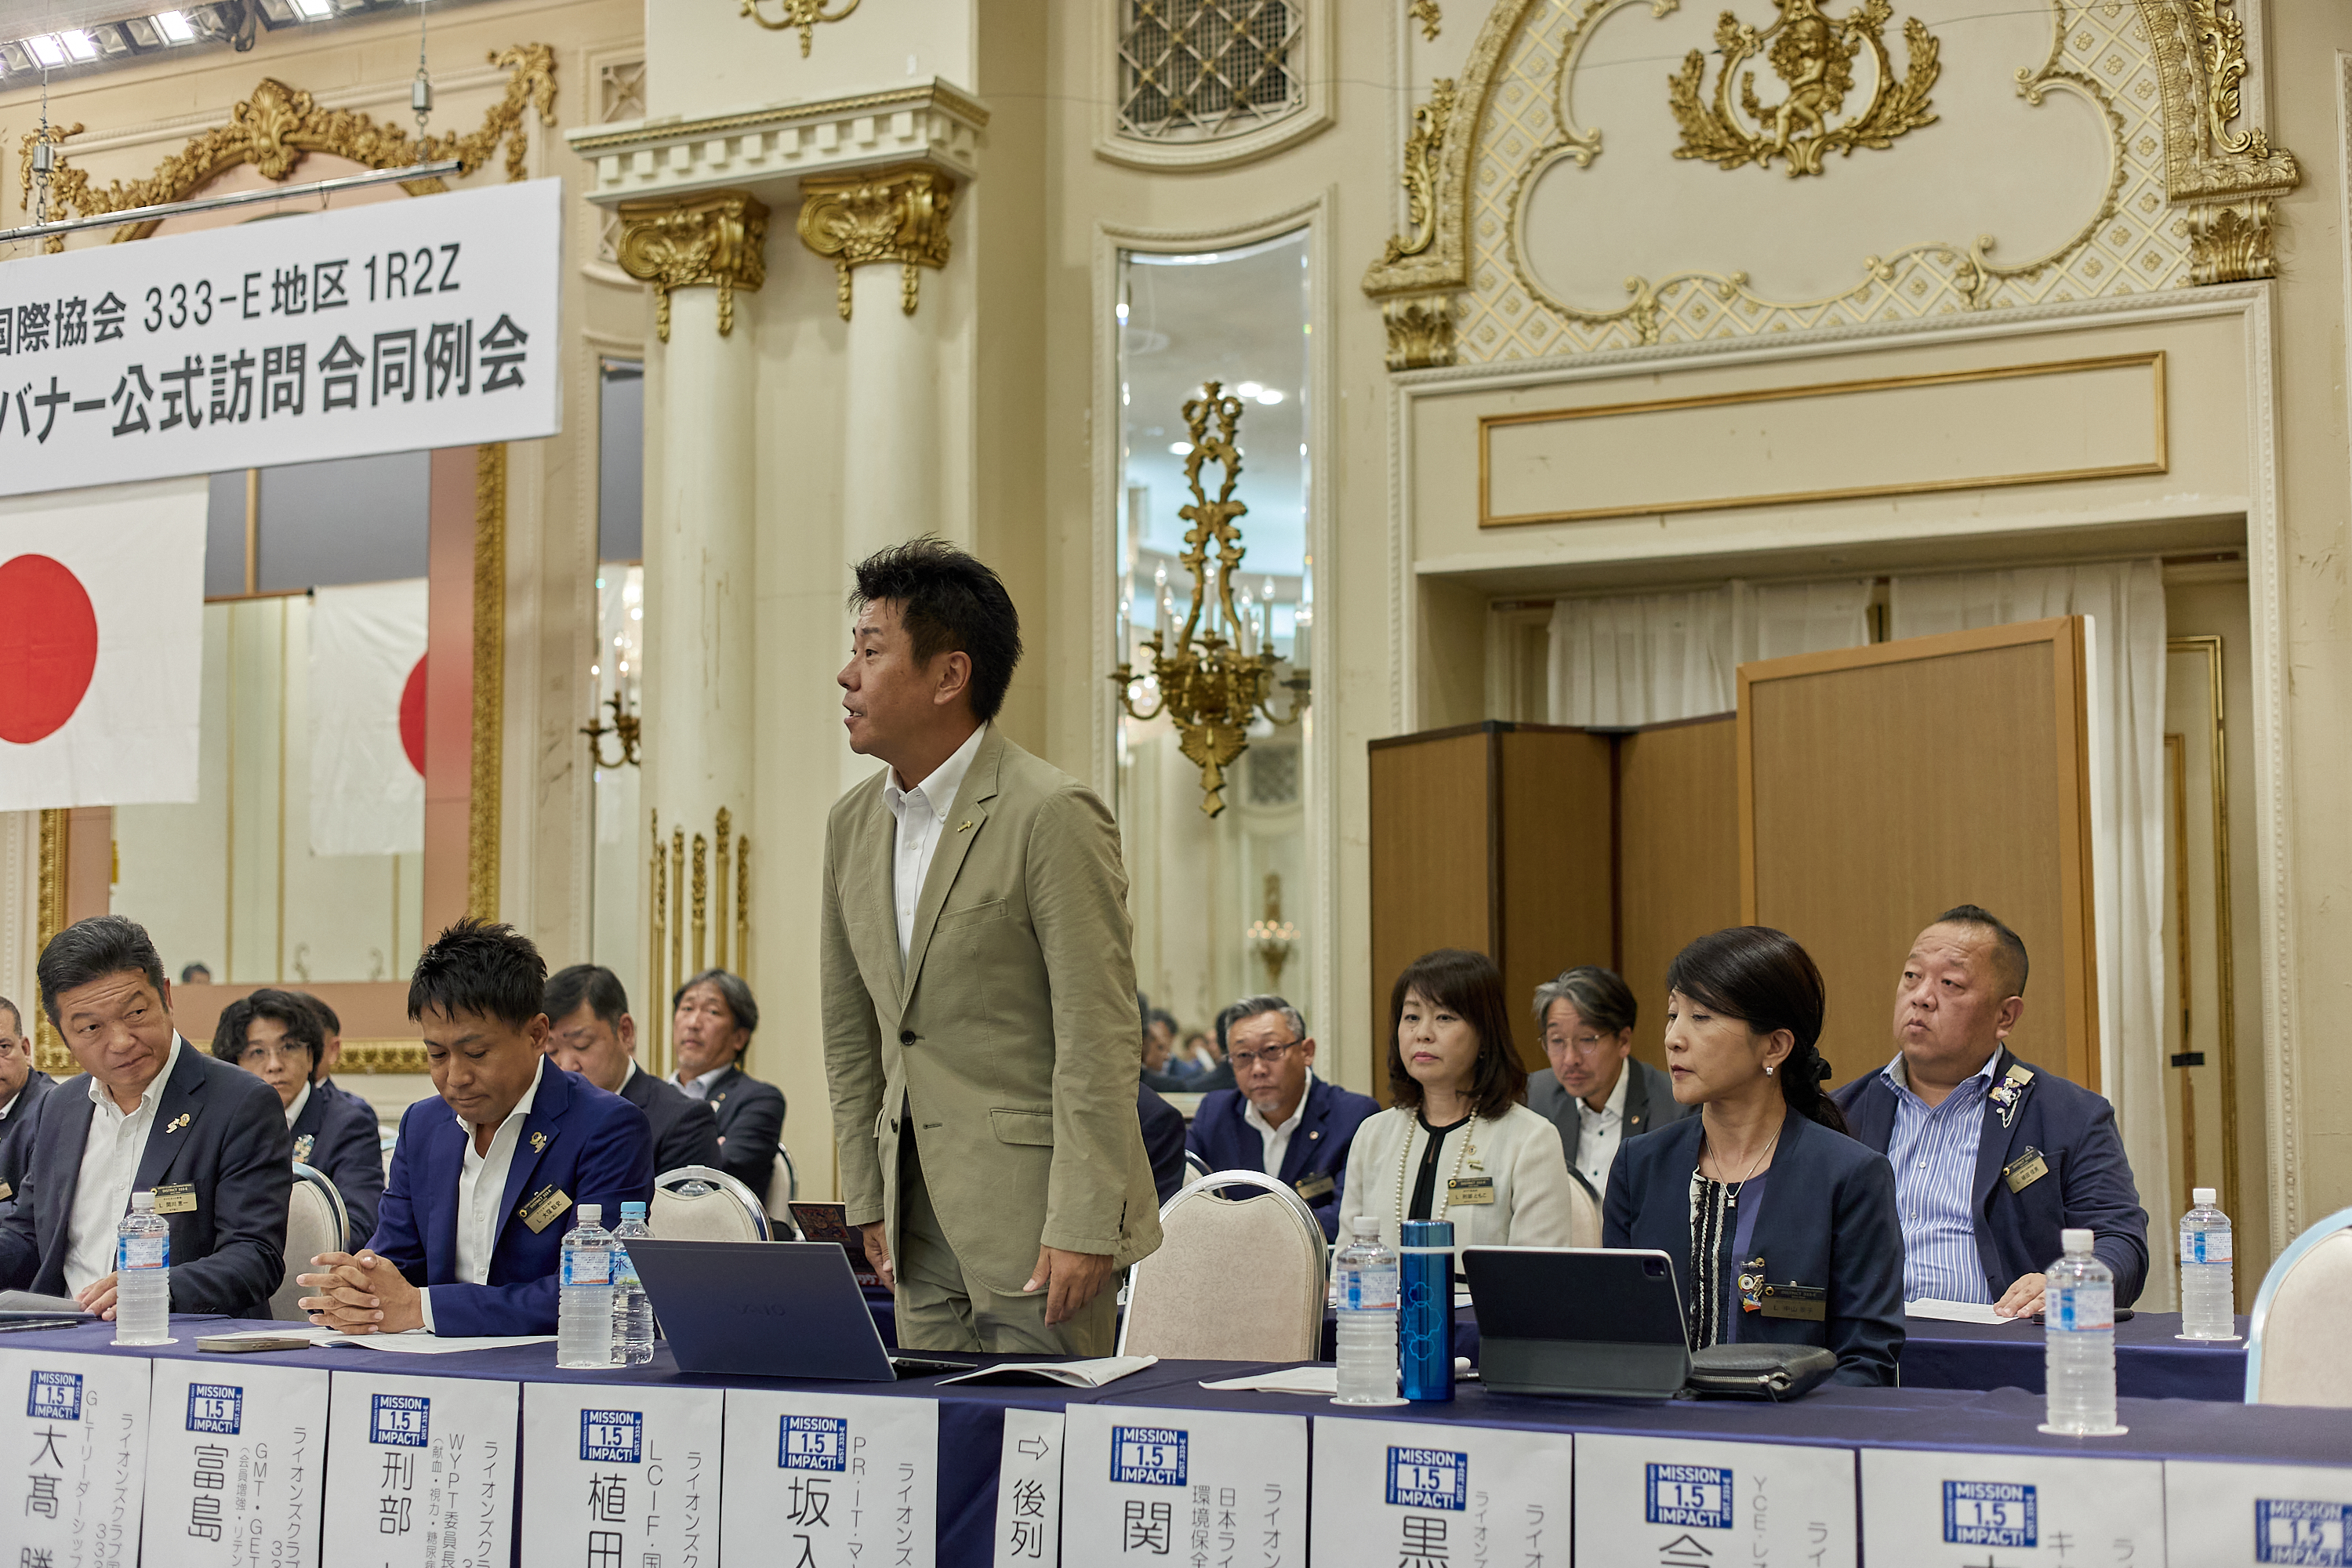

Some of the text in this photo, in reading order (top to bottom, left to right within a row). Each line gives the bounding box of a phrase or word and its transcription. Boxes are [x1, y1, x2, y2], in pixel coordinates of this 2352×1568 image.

[365, 243, 461, 302] 1R2Z
[0, 314, 528, 445] バナー公式訪問合同例会
[615, 1258, 629, 1271] 水
[38, 1372, 75, 1385] MISSION
[47, 1386, 64, 1404] 1.5
[196, 1385, 235, 1399] MISSION
[380, 1396, 422, 1410] MISSION
[34, 1405, 73, 1419] IMPACT!
[205, 1399, 223, 1418] 1.5
[590, 1411, 634, 1425] MISSION
[194, 1419, 233, 1433] IMPACT!
[390, 1411, 410, 1430] 1.5
[789, 1417, 837, 1432] MISSION
[378, 1431, 420, 1446] IMPACT!
[601, 1426, 622, 1446] 1.5
[801, 1433, 825, 1454] 1.5
[1123, 1428, 1178, 1444] MISSION
[589, 1446, 633, 1461] IMPACT!
[788, 1454, 837, 1470] IMPACT!
[1137, 1445, 1163, 1466] 1.5
[1399, 1448, 1456, 1467] MISSION
[1121, 1467, 1177, 1484] IMPACT!
[1413, 1466, 1440, 1490] 1.5
[1658, 1465, 1720, 1484] MISSION
[188, 1443, 229, 1542] 富島
[379, 1451, 414, 1537] 刑部
[847, 1436, 866, 1568] PR・IT・マ
[1397, 1490, 1454, 1509] IMPACT!
[1675, 1484, 1704, 1508] 1.5
[1956, 1483, 2024, 1501] MISSION
[588, 1472, 627, 1568] 植田
[683, 1452, 702, 1568] ライオンズク
[895, 1463, 914, 1566] ライオンズ
[1011, 1479, 1046, 1559] 後列
[1658, 1508, 1720, 1527] IMPACT!
[1974, 1502, 2006, 1526] 1.5
[787, 1475, 832, 1568] 坂入
[1123, 1500, 1171, 1555] 関
[1190, 1485, 1210, 1568] 環境保全
[1218, 1487, 1236, 1568] 日本ライ
[1263, 1483, 1282, 1568] ライオン
[1752, 1475, 1769, 1568] YCE・レ
[1399, 1515, 1450, 1568] 黒
[1525, 1504, 1544, 1568] ライオ
[1807, 1522, 1828, 1567] ライ
[2290, 1520, 2324, 1550] 1.5
[2047, 1530, 2074, 1568] キ
[2113, 1539, 2134, 1568] ラ
